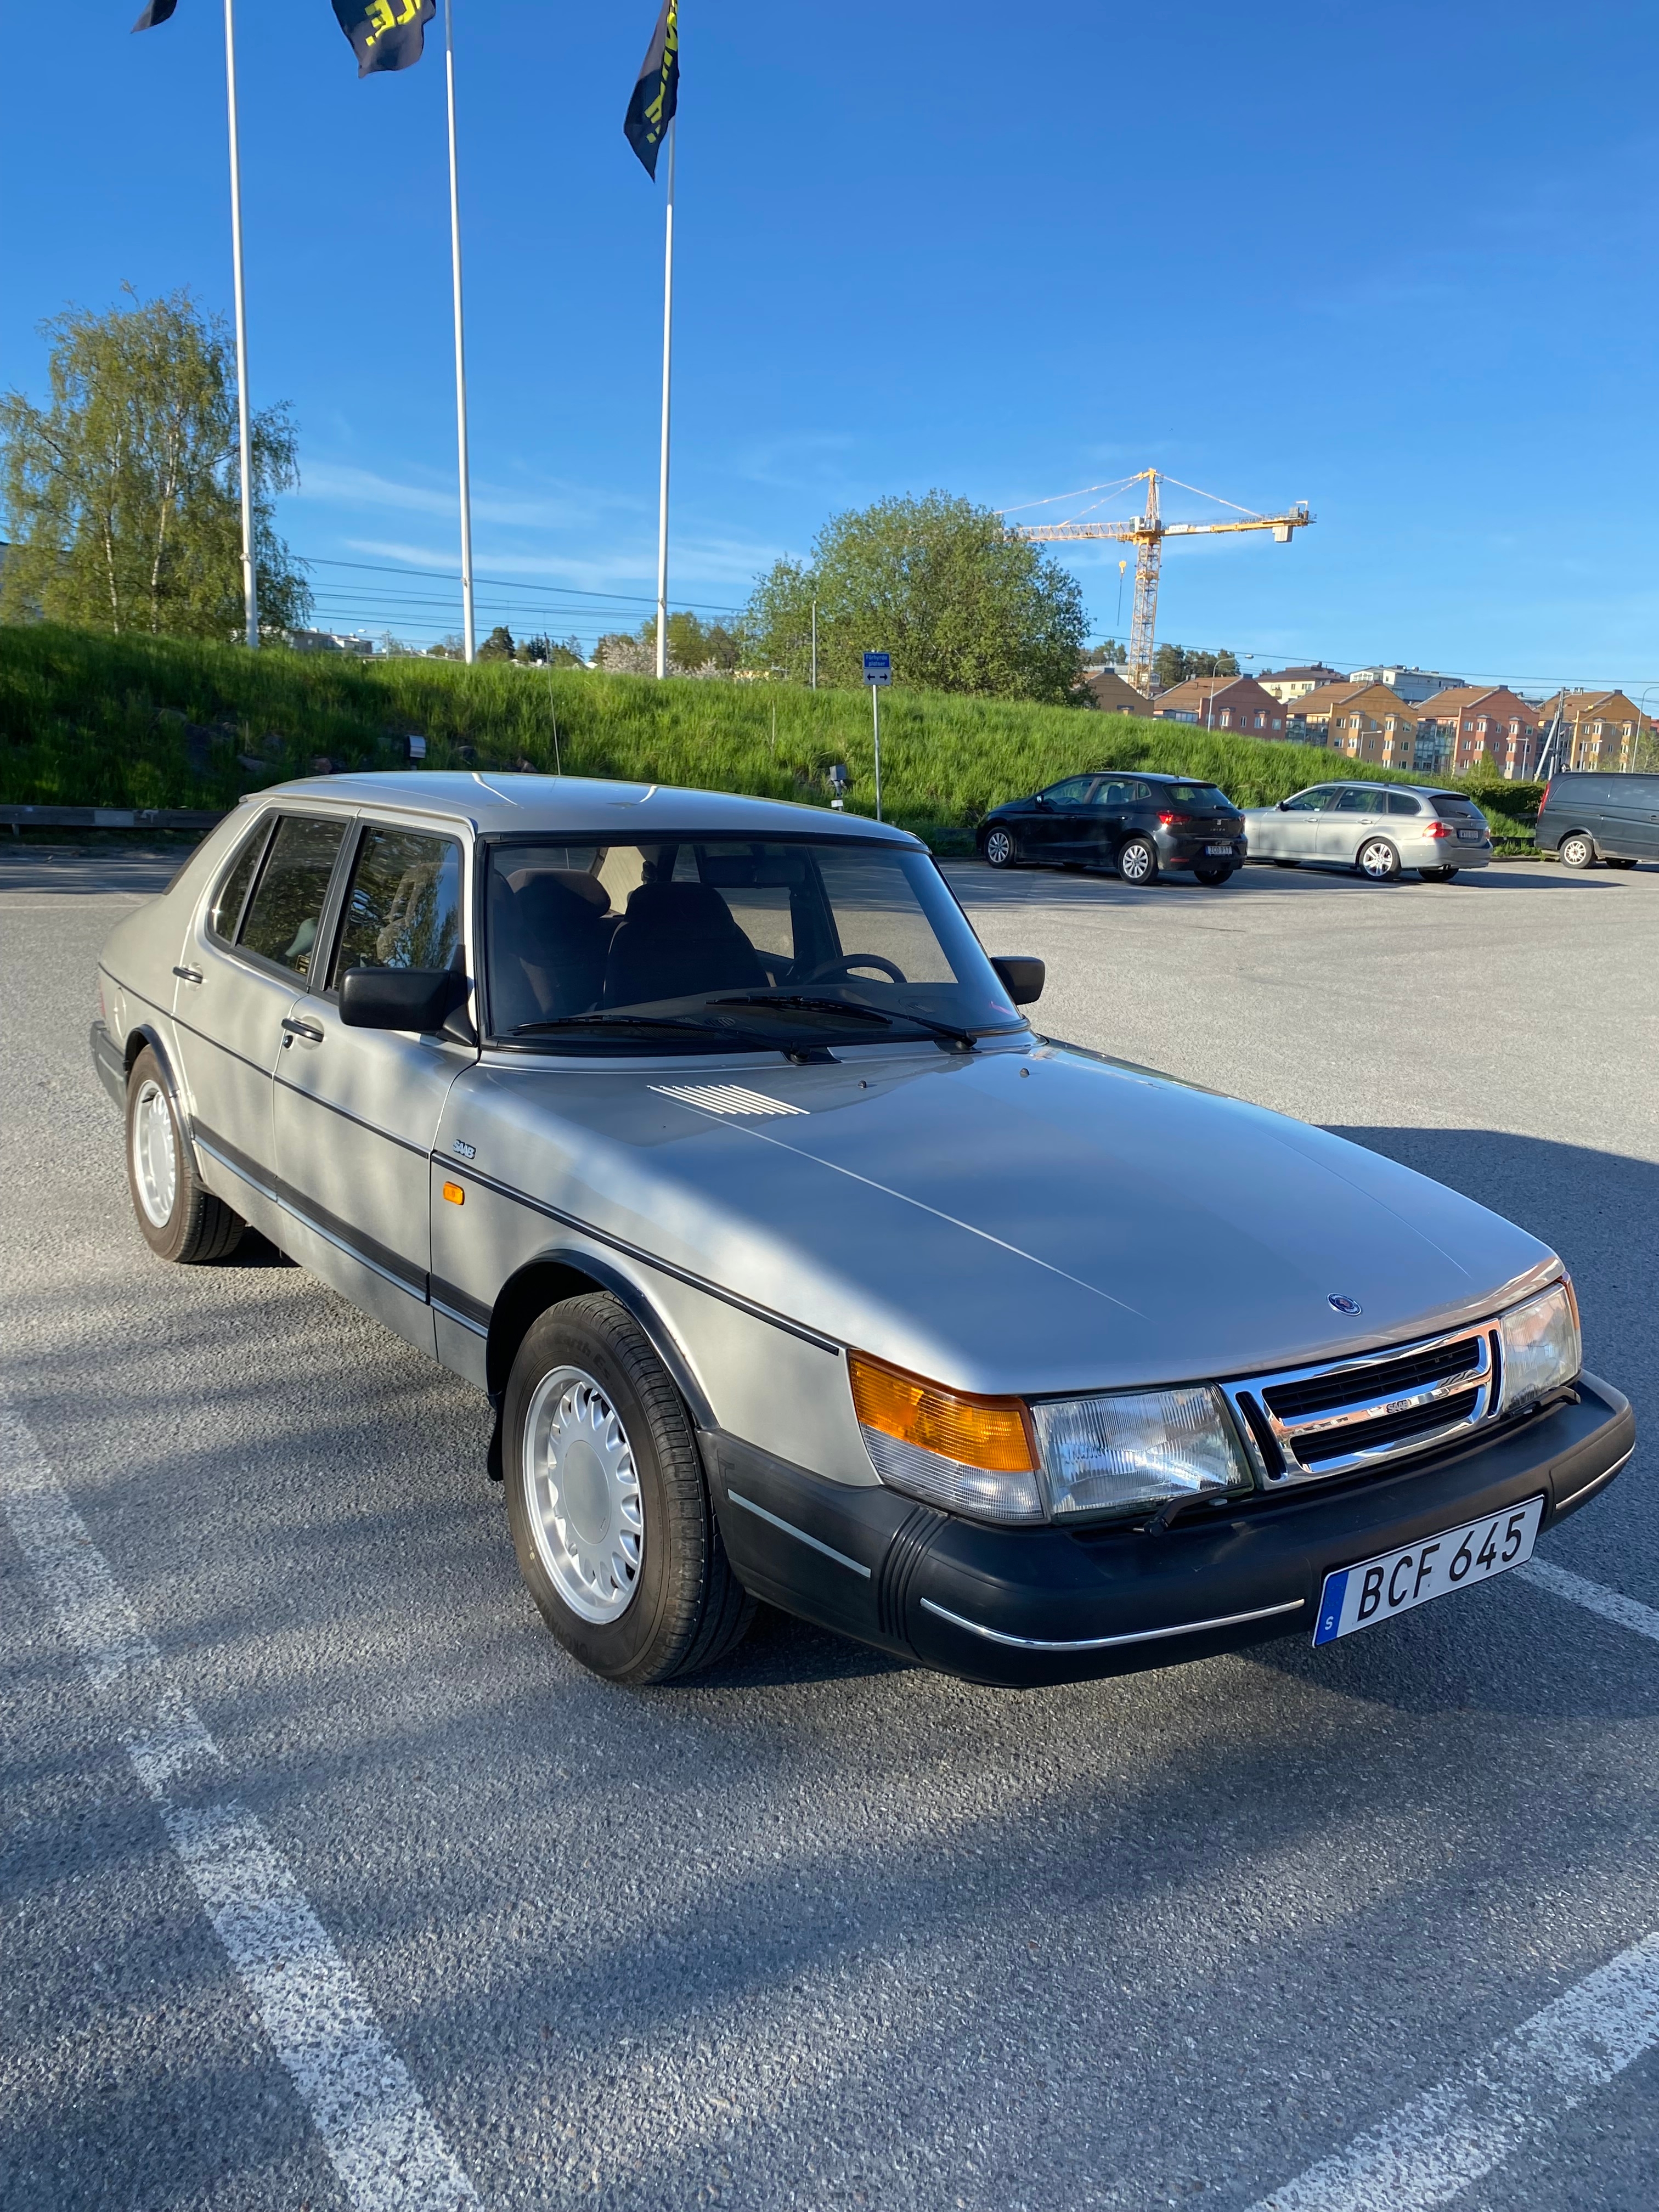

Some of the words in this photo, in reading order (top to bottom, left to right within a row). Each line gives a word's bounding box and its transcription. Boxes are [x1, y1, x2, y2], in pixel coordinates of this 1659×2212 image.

[453, 1139, 476, 1159] SAAB
[1387, 1400, 1408, 1413] SAAB
[1357, 1543, 1441, 1622] BCF
[1449, 1511, 1526, 1582] 645
[1324, 1616, 1334, 1630] S
